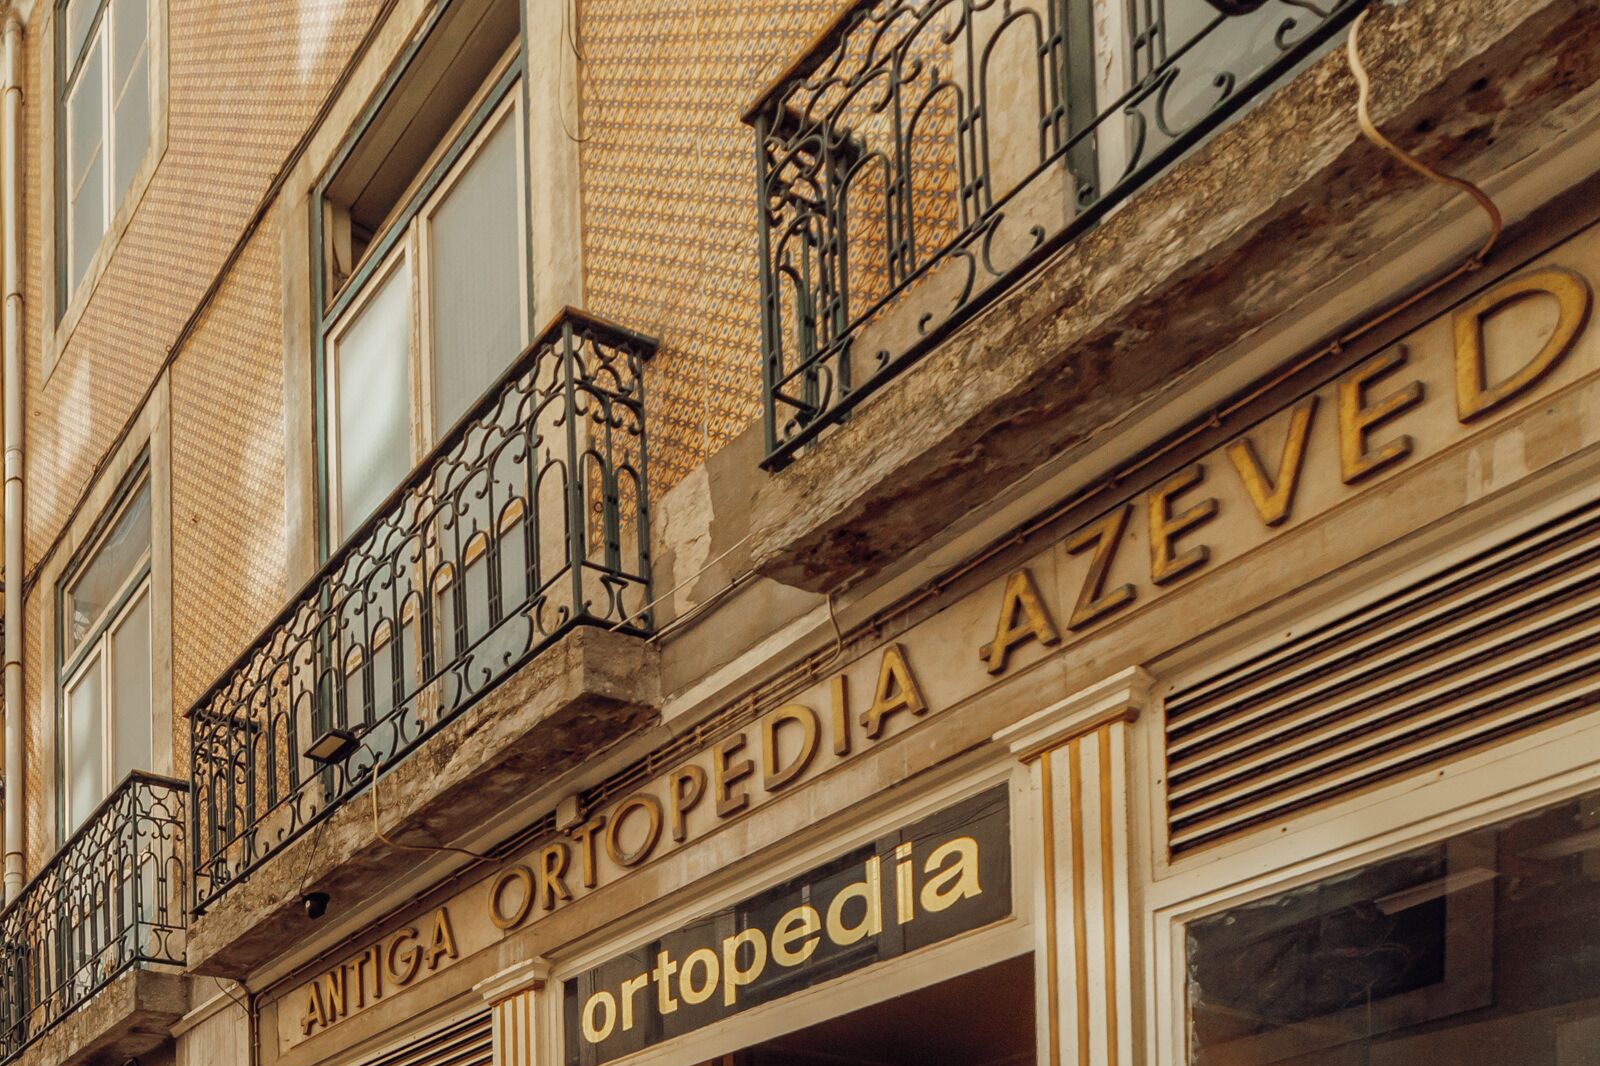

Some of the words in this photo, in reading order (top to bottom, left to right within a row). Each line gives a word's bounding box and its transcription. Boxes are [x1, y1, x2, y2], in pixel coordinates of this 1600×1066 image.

[300, 906, 460, 1037] ANTIGA
[488, 643, 929, 930] ORTOPEDIA
[978, 263, 1594, 676] AZEVED
[581, 834, 984, 1045] ortopedia
